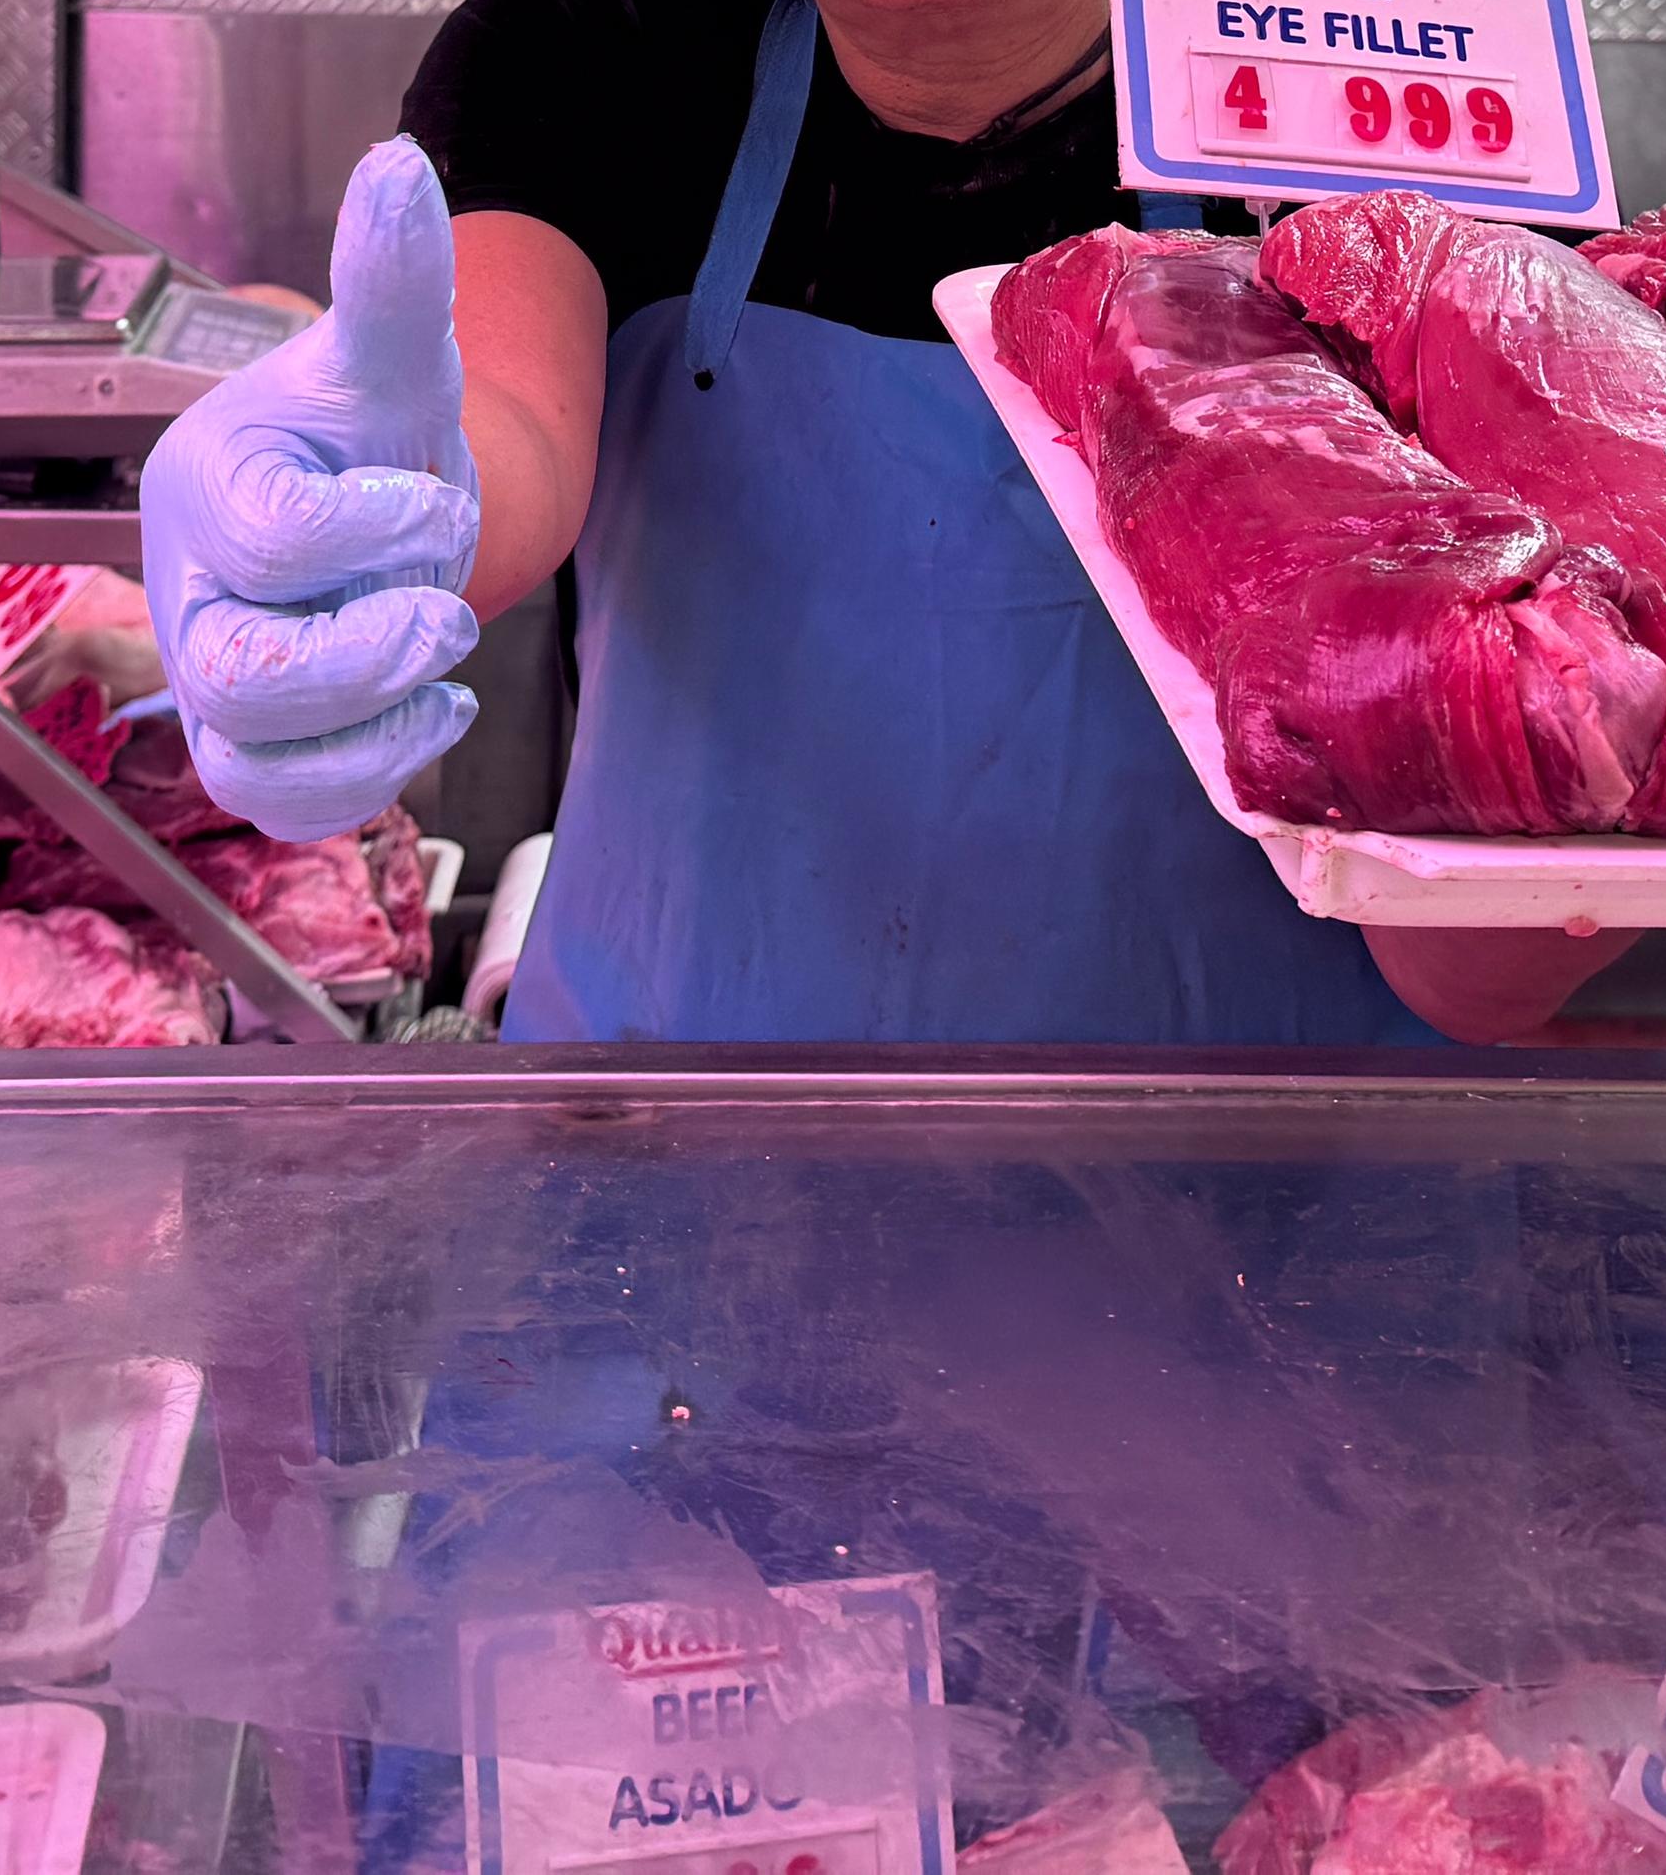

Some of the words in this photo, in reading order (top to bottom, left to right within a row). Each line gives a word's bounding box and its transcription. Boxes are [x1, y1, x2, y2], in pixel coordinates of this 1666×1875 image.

[1217, 0, 1307, 45] EYE
[1323, 11, 1474, 63] FILLET
[1224, 65, 1268, 130] 4
[652, 1683, 771, 1745] BEEF
